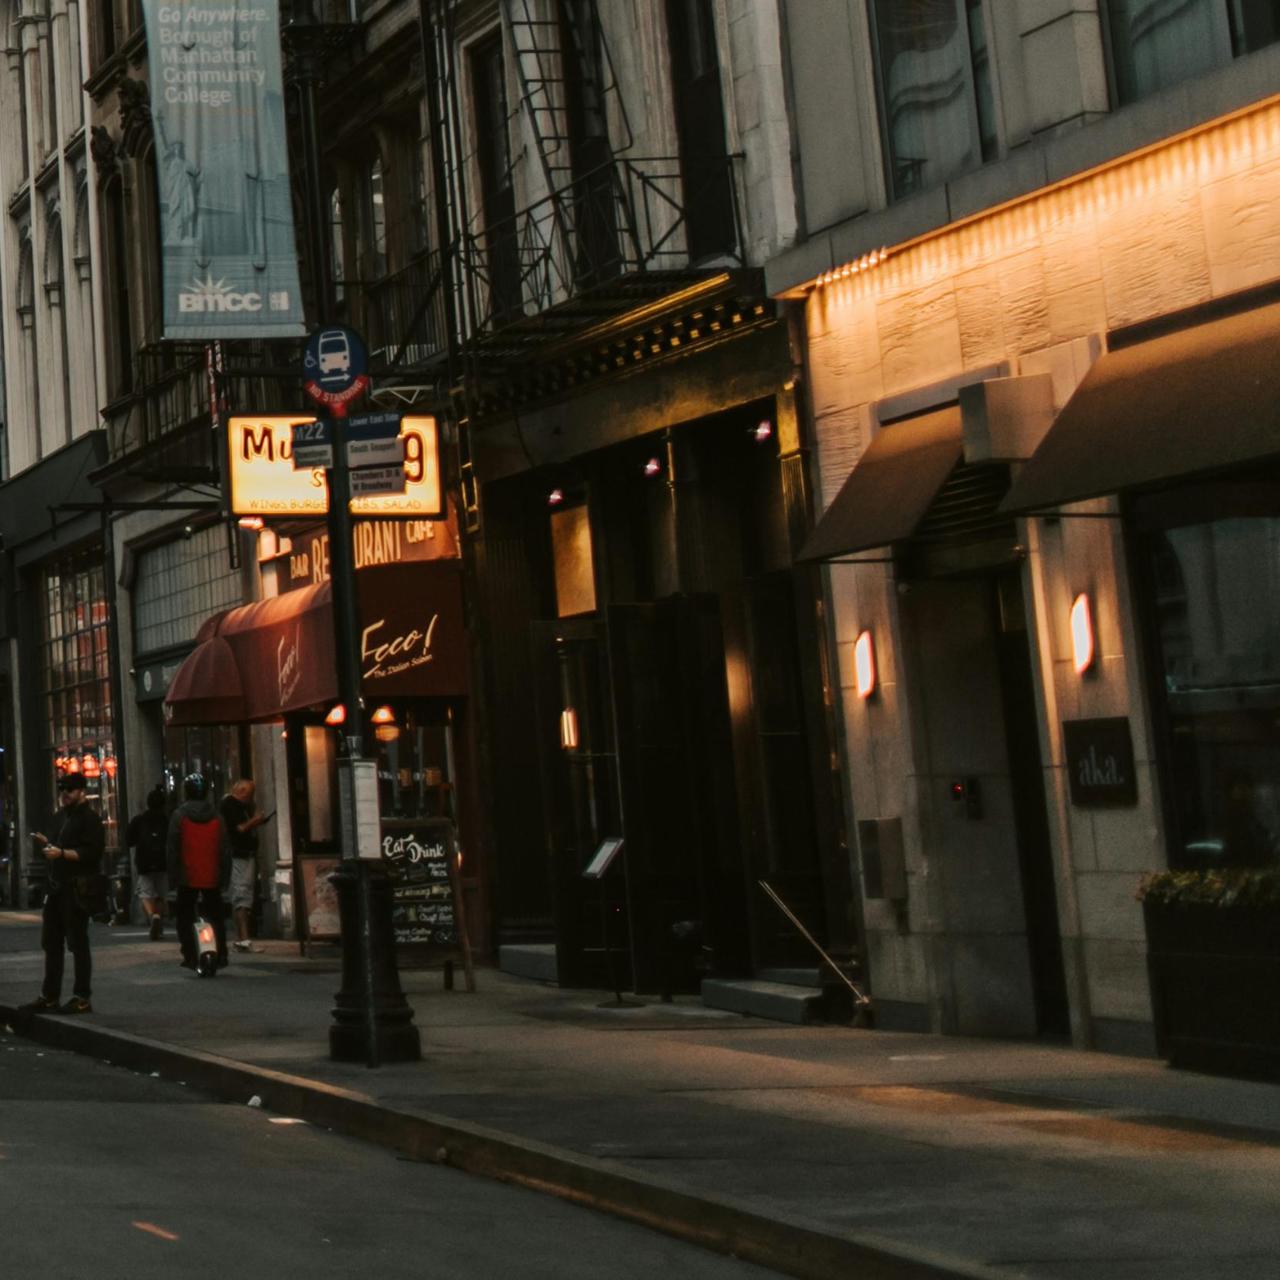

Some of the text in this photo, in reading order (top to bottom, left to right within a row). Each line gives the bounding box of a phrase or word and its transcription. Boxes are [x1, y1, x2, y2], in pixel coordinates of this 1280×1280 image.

[158, 6, 270, 26] Go Anywhere.
[159, 26, 259, 48] Borough of
[161, 47, 257, 65] Manhattan
[163, 67, 267, 87] Community
[164, 86, 233, 108] College
[310, 379, 363, 402] NO STANDING
[289, 498, 328, 510] BURGE
[352, 498, 378, 510] IBS,
[383, 498, 422, 510] SALAD
[291, 553, 309, 579] BAR
[382, 833, 445, 863] Eat Drink
